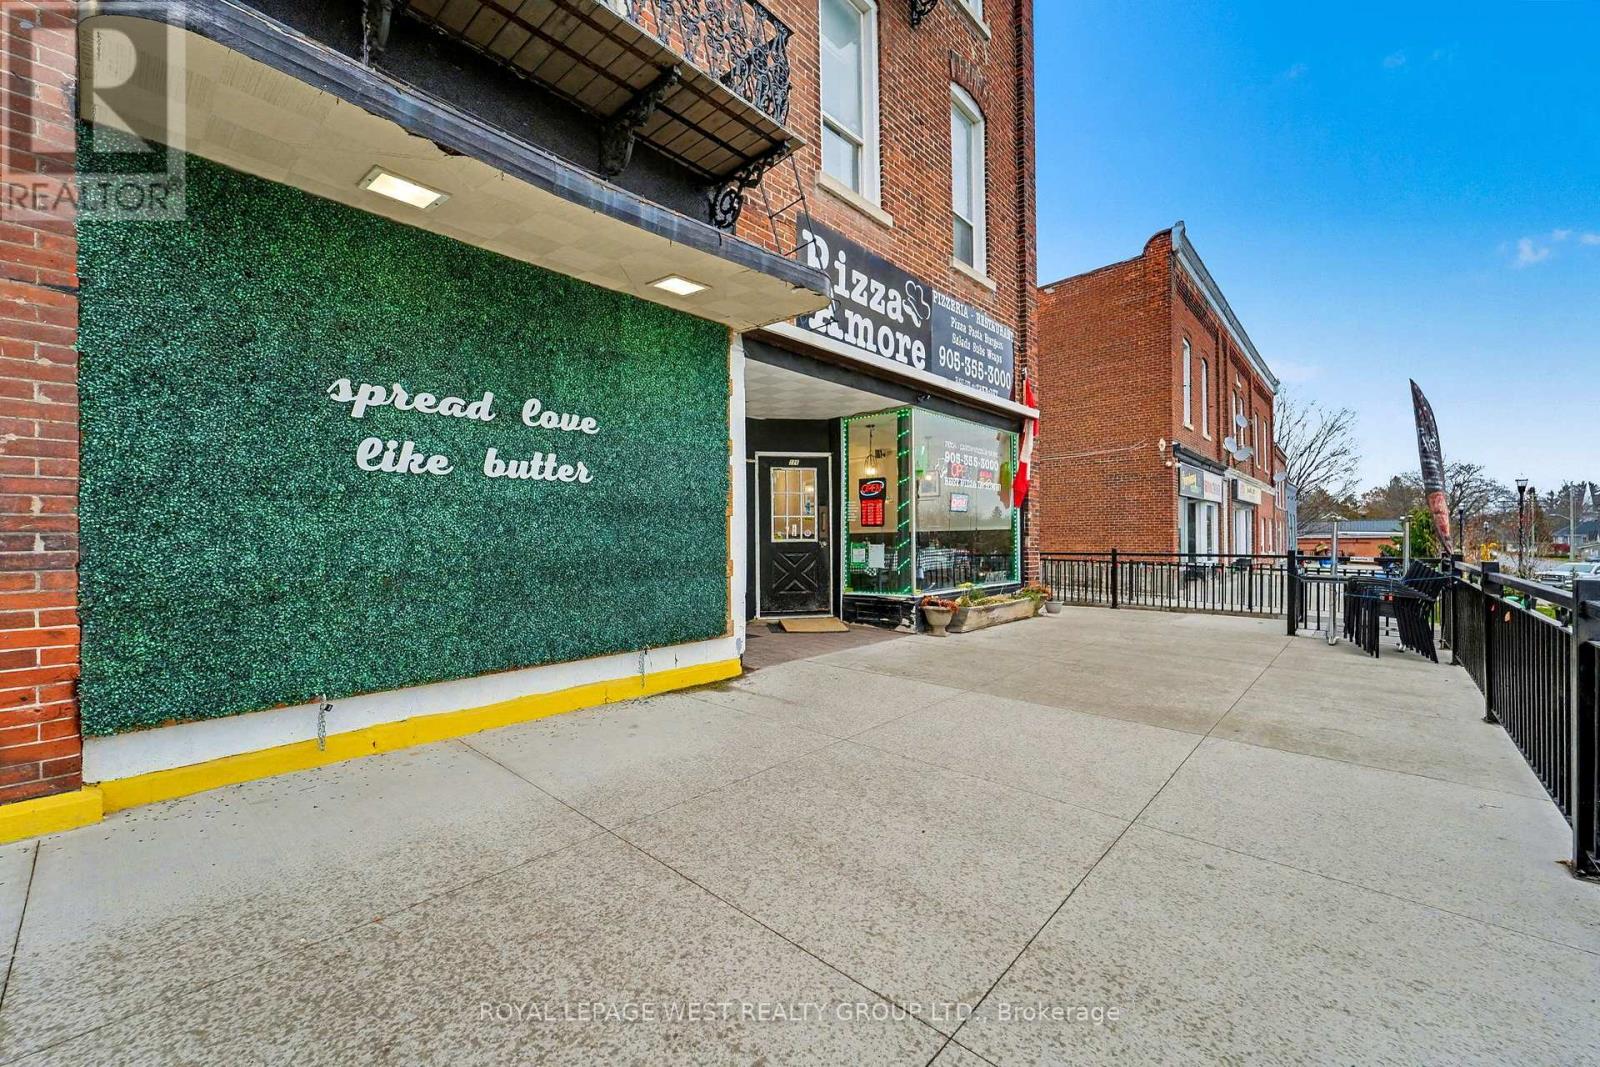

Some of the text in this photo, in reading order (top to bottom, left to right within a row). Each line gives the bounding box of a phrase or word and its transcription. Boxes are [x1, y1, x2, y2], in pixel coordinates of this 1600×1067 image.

[802, 229, 904, 324] Pizza
[931, 289, 969, 319] PIZZERIA
[326, 378, 600, 435] spread love
[356, 437, 594, 484] like butter
